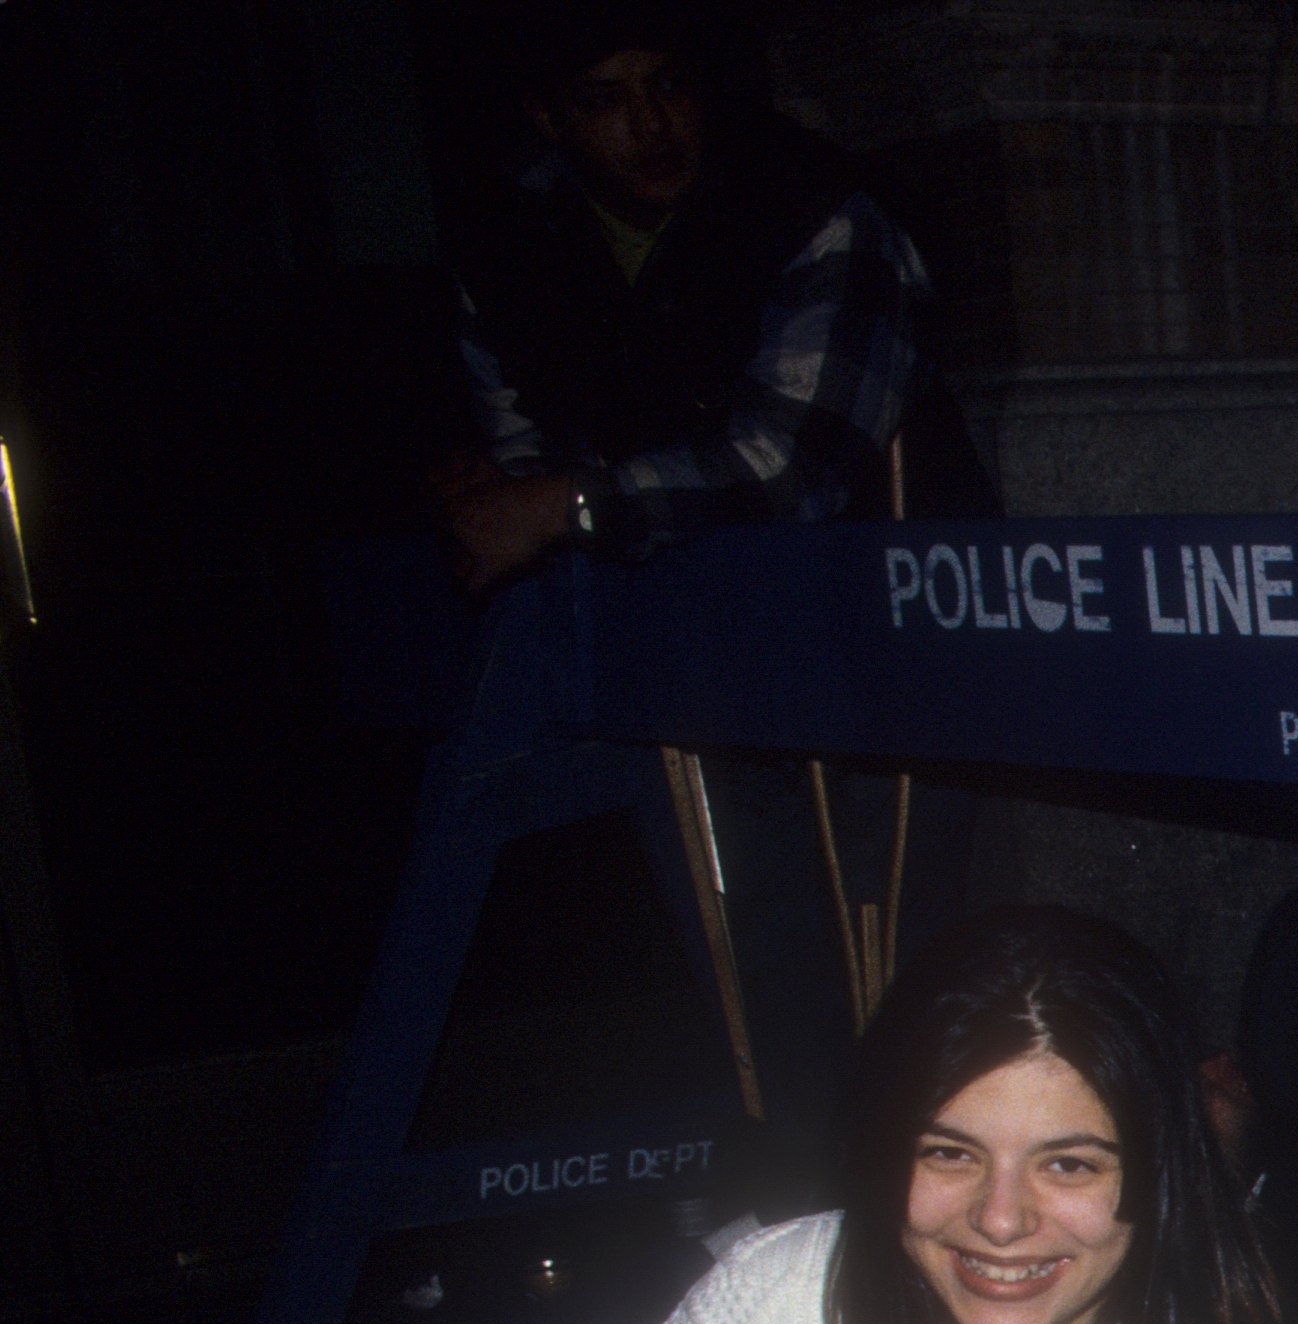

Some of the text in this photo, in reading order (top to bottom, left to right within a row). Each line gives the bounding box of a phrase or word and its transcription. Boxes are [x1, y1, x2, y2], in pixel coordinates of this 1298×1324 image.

[885, 542, 1112, 633] POLICE
[479, 1140, 714, 1200] POLICE DEPT
